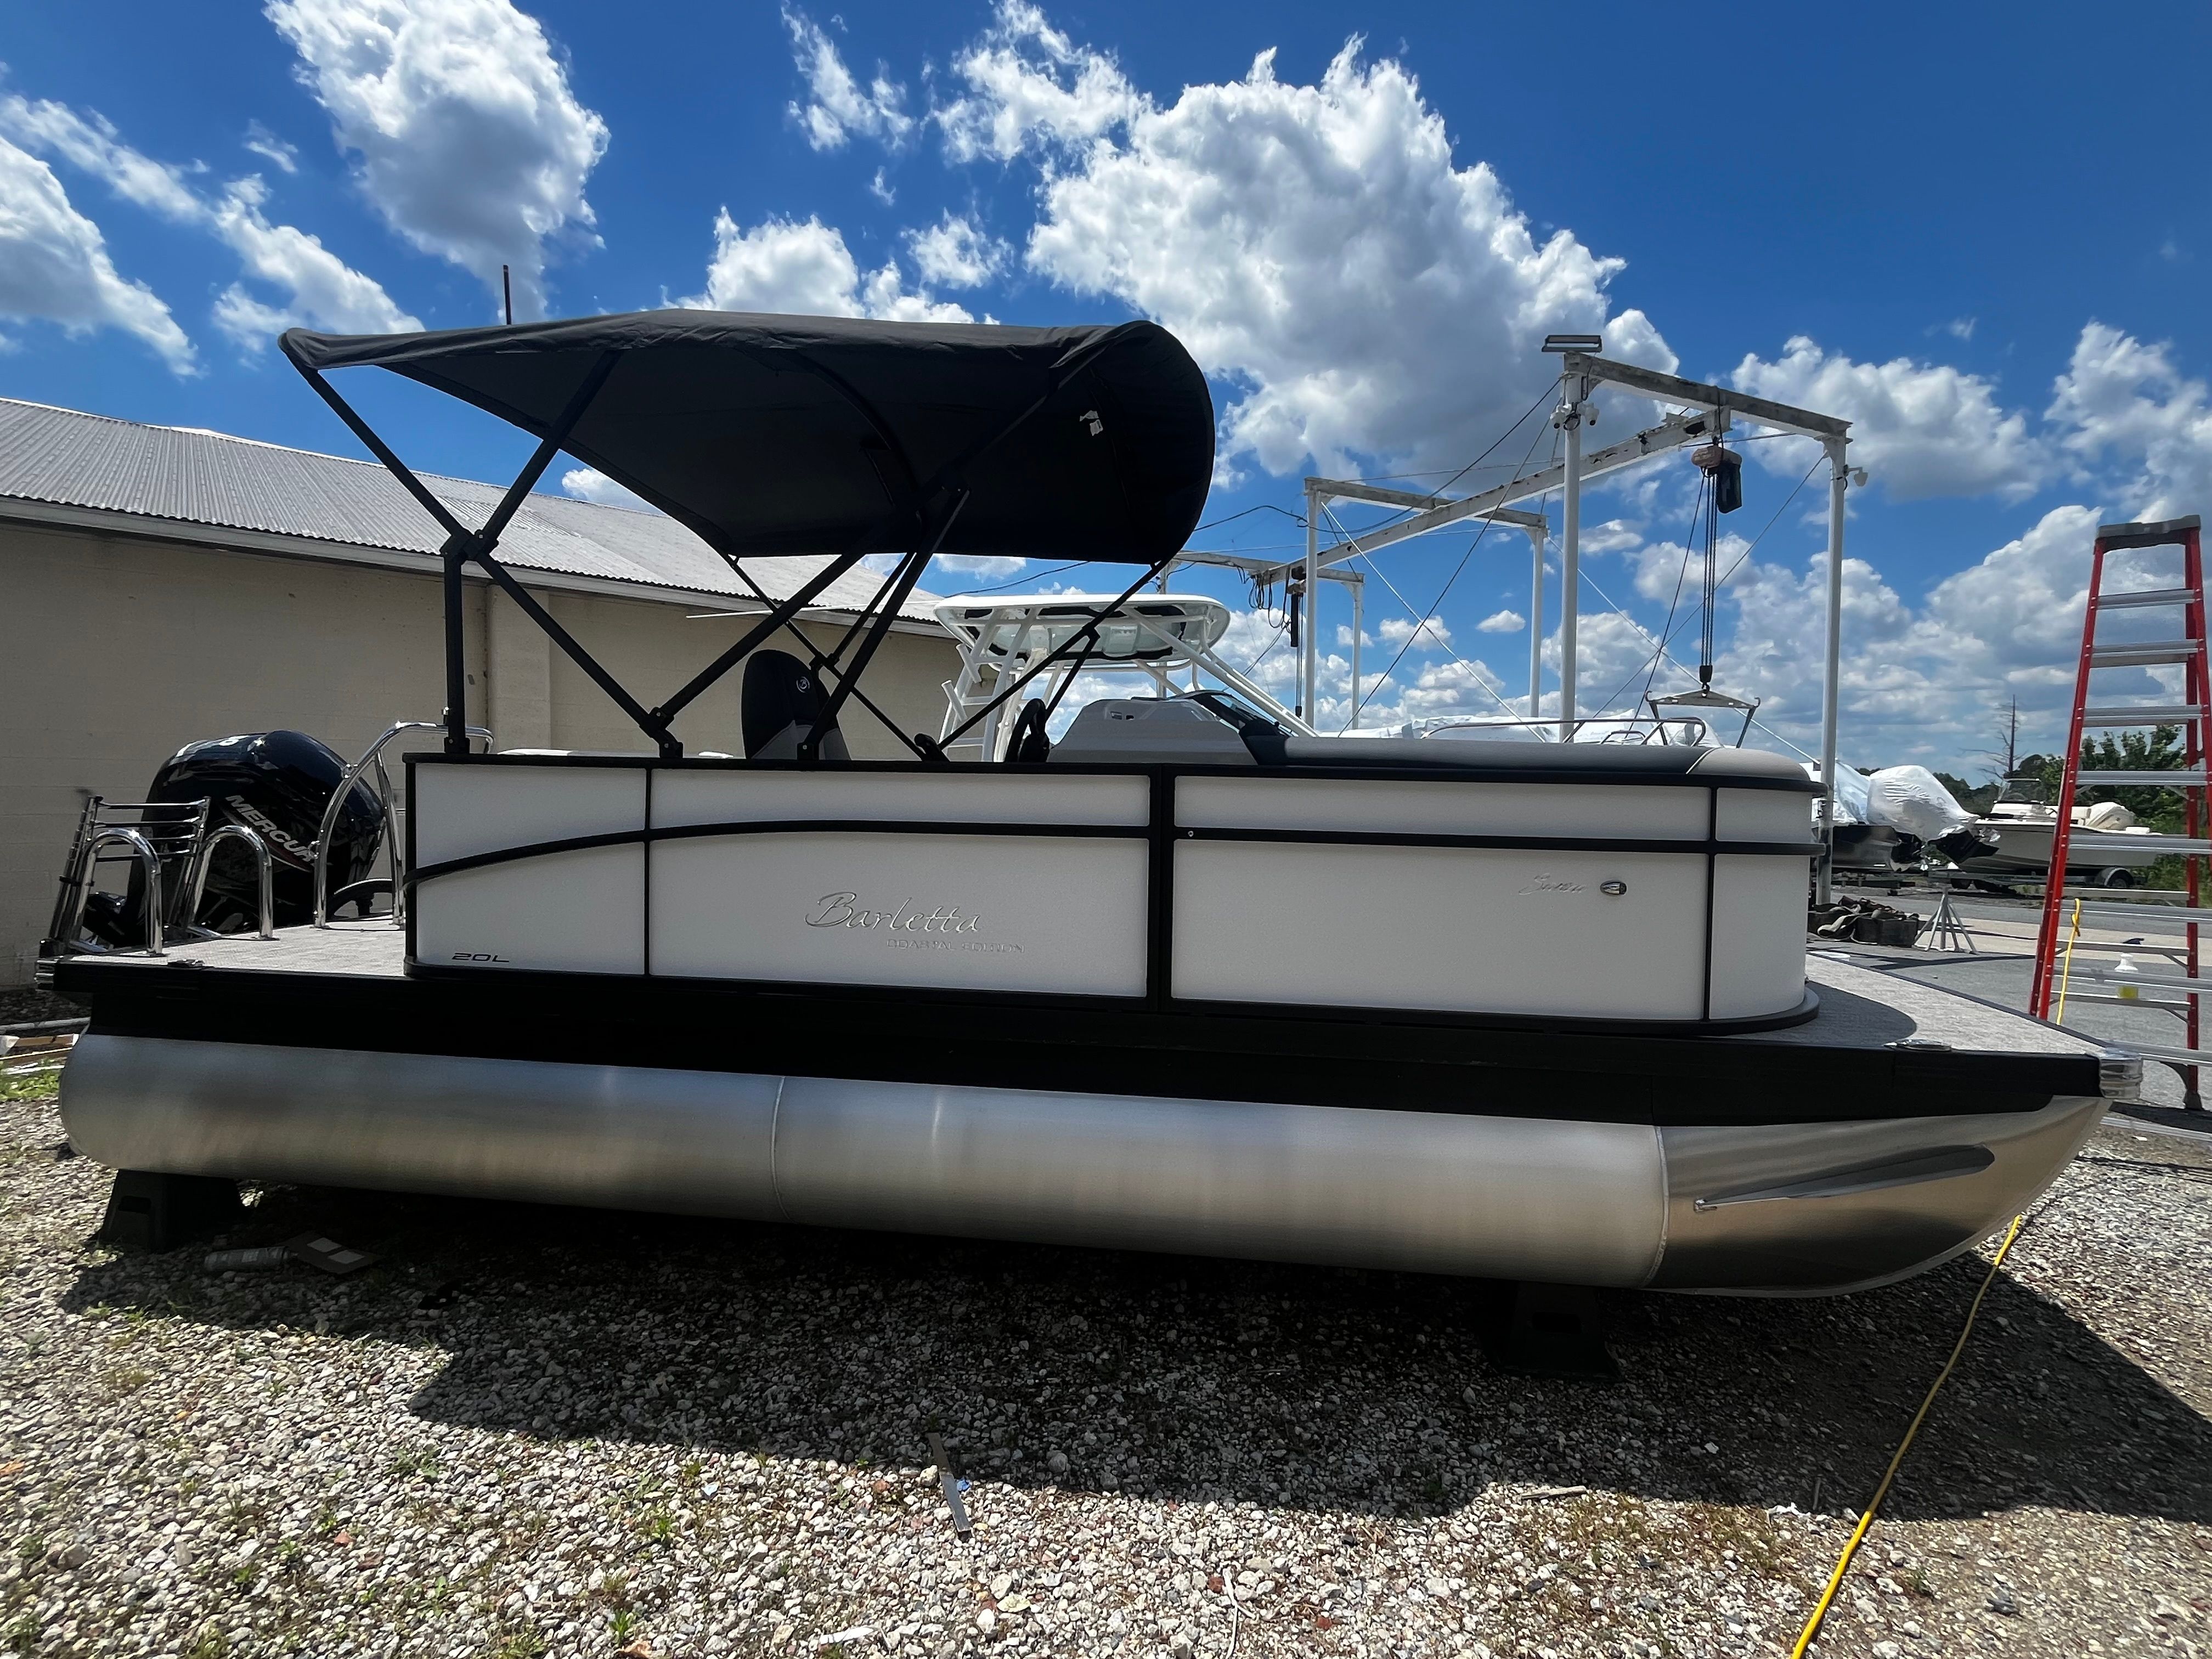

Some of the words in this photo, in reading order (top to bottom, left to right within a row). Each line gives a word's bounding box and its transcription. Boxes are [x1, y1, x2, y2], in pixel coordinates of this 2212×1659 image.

[225, 795, 318, 862] MERCUR
[805, 891, 981, 934] Barletta
[452, 952, 509, 963] 20L
